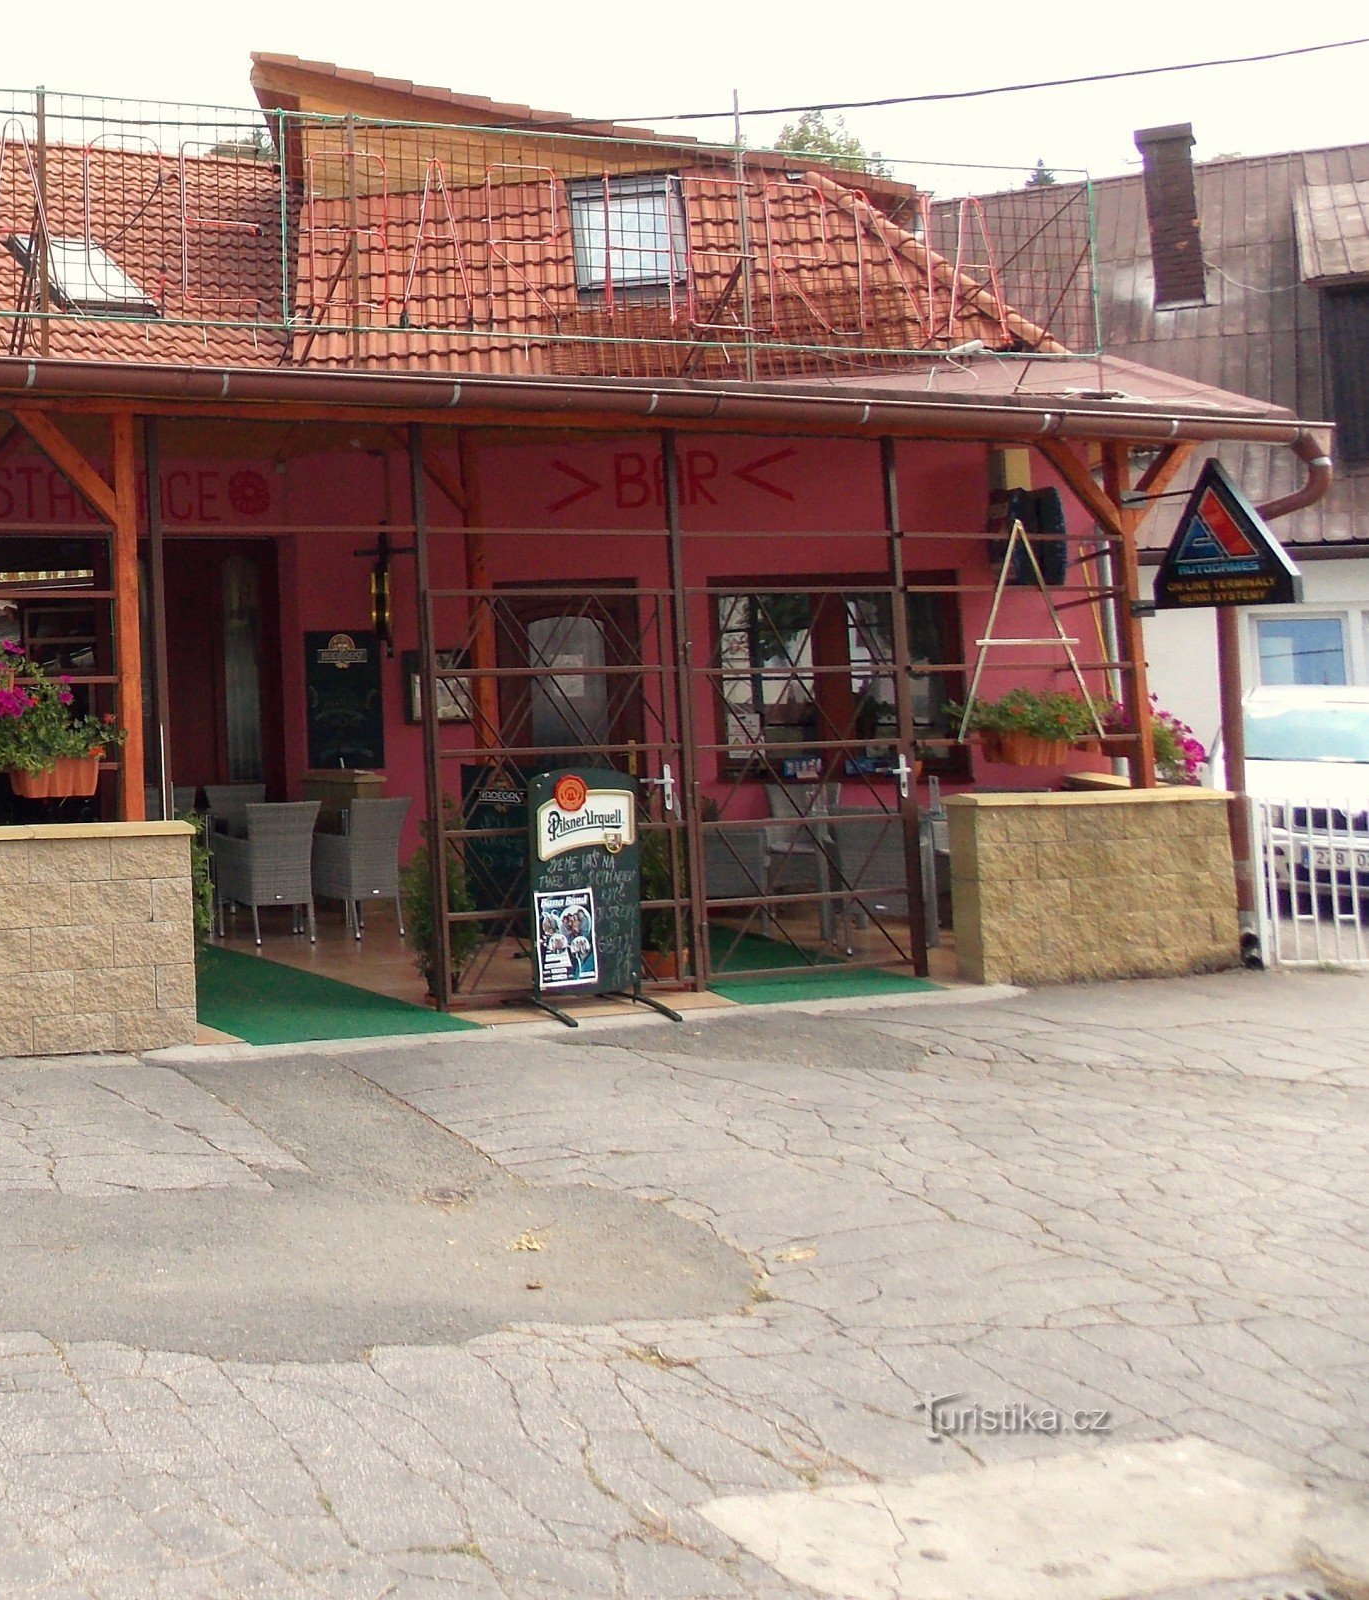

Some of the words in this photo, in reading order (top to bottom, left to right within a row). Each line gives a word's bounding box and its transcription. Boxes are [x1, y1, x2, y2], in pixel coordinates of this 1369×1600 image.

[614, 450, 717, 509] BAR
[547, 810, 587, 842] Pilsner
[585, 808, 622, 831] Urquell
